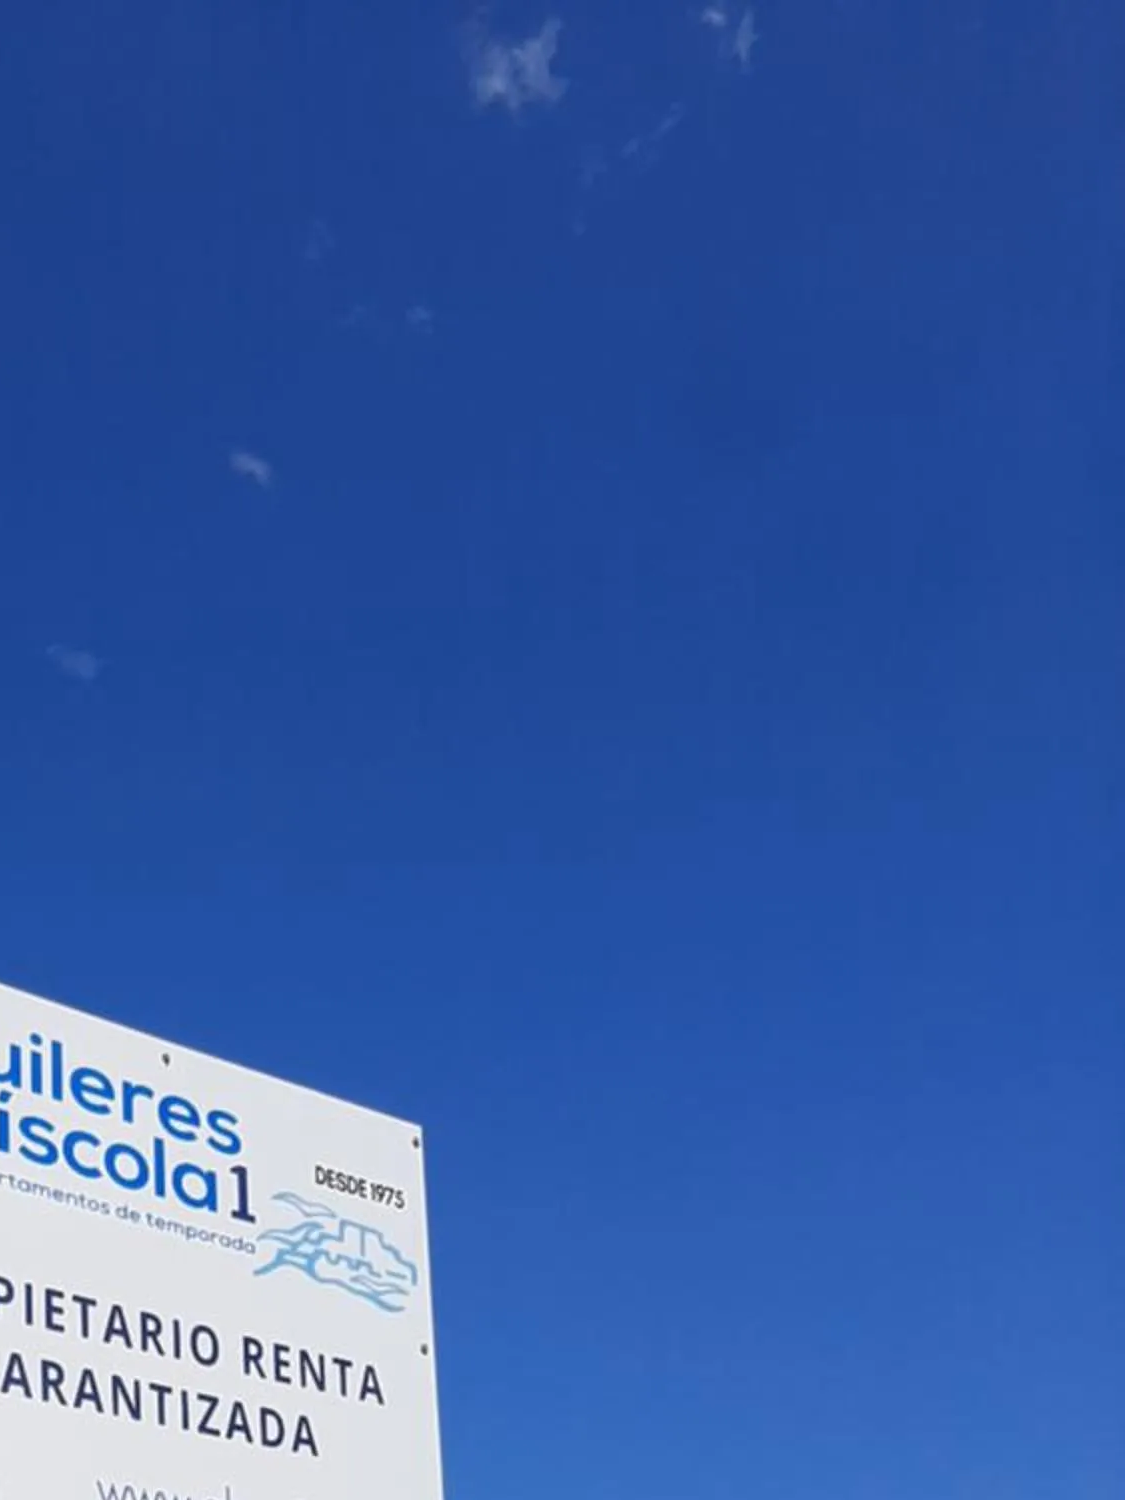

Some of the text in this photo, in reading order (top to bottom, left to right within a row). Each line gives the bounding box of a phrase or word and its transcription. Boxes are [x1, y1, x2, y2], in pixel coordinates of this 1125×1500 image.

[315, 1165, 405, 1209] DESDE 1975
[115, 1206, 141, 1222] de
[146, 1213, 256, 1254] temporada
[243, 1336, 385, 1406] RENTA
